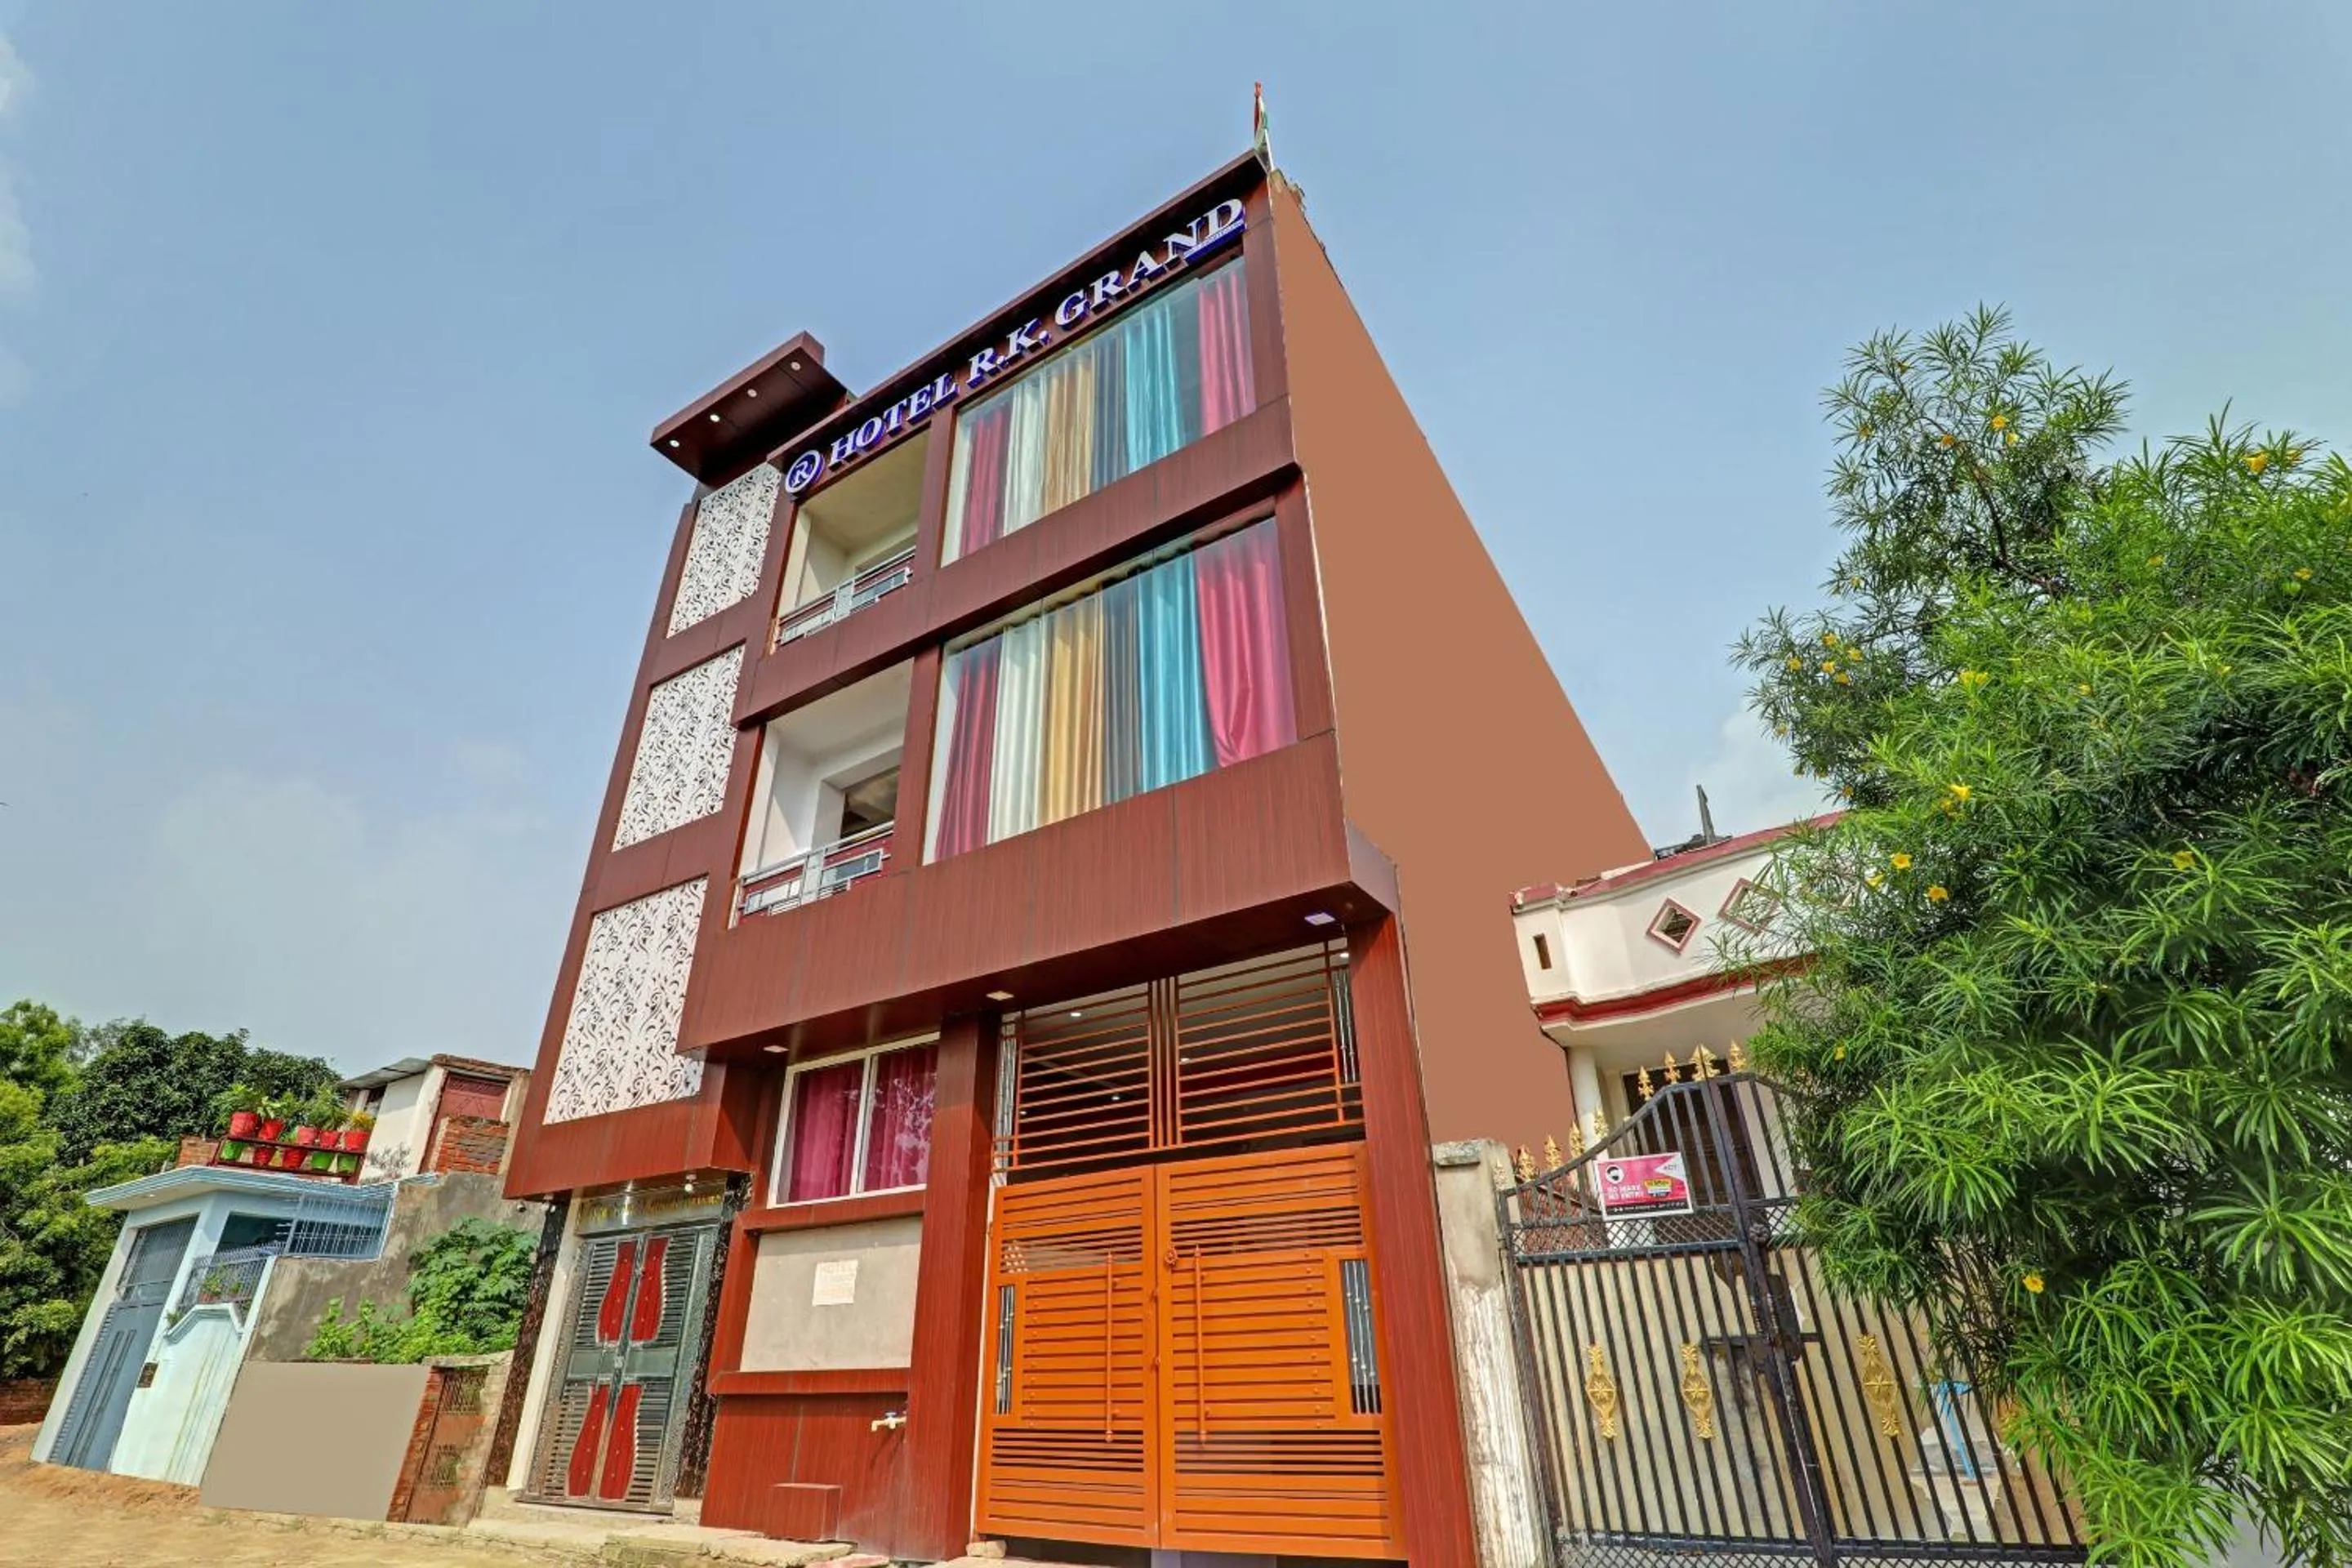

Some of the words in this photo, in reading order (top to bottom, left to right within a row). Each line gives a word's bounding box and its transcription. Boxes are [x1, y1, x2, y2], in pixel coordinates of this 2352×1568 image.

[828, 373, 957, 469] HOTEL
[966, 318, 1050, 385] R.K.
[1054, 198, 1244, 327] GRAND
